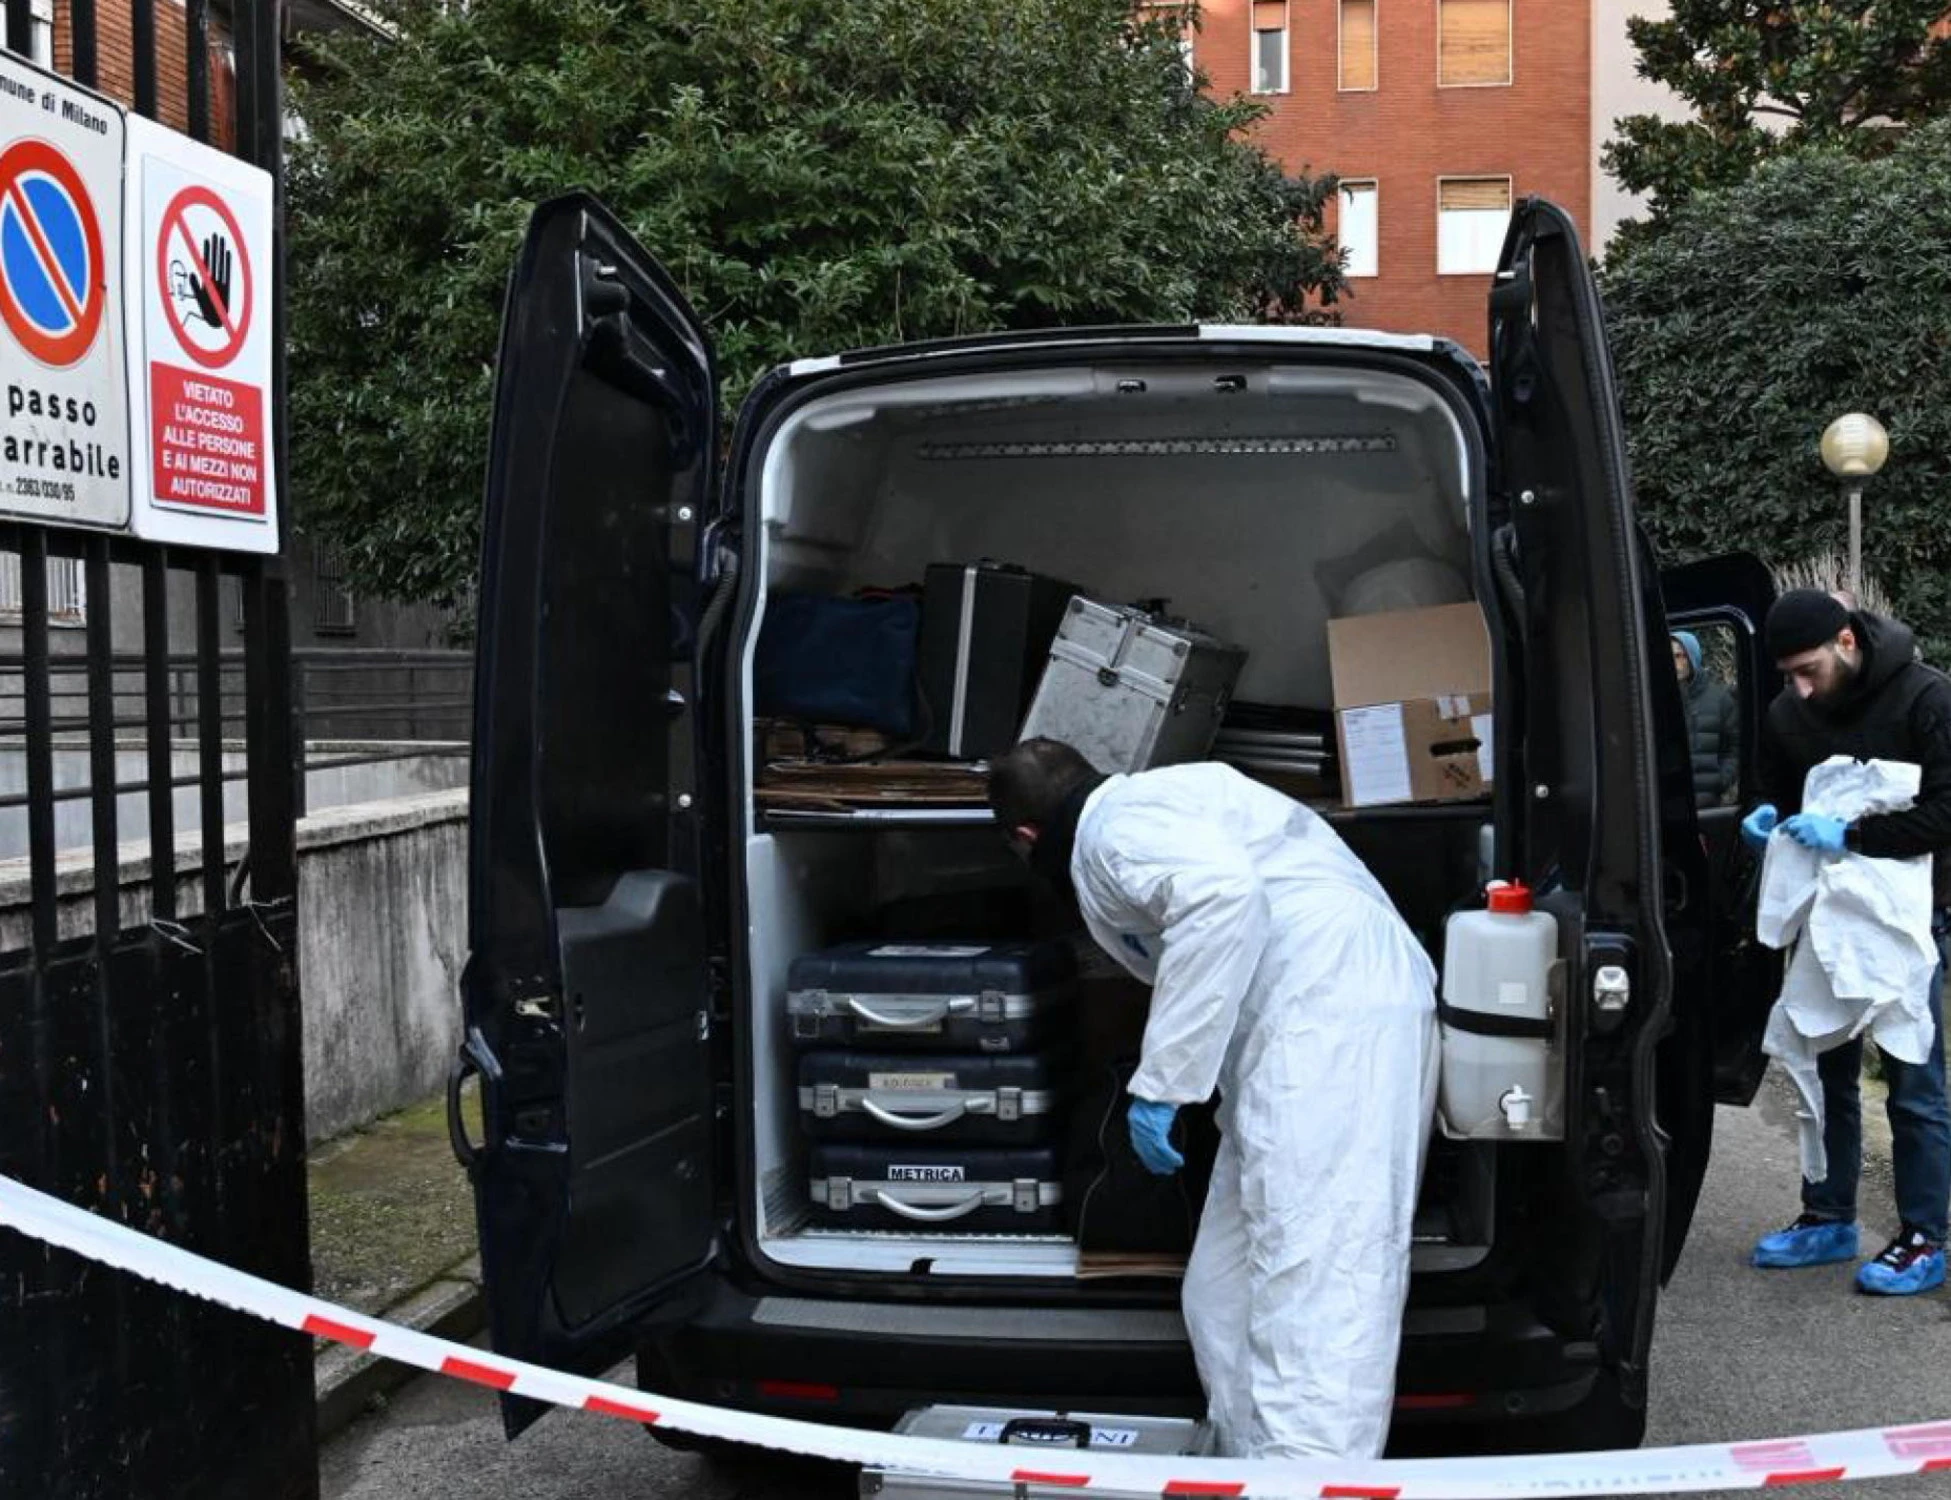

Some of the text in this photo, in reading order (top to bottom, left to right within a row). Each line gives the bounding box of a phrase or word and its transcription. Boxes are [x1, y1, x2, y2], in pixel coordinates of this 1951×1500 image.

[42, 92, 55, 113] di
[62, 98, 107, 135] Milano
[8, 384, 96, 427] passo
[183, 380, 234, 408] VIETATO
[174, 402, 243, 434] L'ACCESSO
[3, 436, 120, 479] arrabile
[162, 426, 255, 459] ALLE PERSONE
[162, 449, 257, 483] E AI MEZZI NON
[171, 476, 250, 505] AUTORIZZATI
[891, 1167, 962, 1182] METRICA
